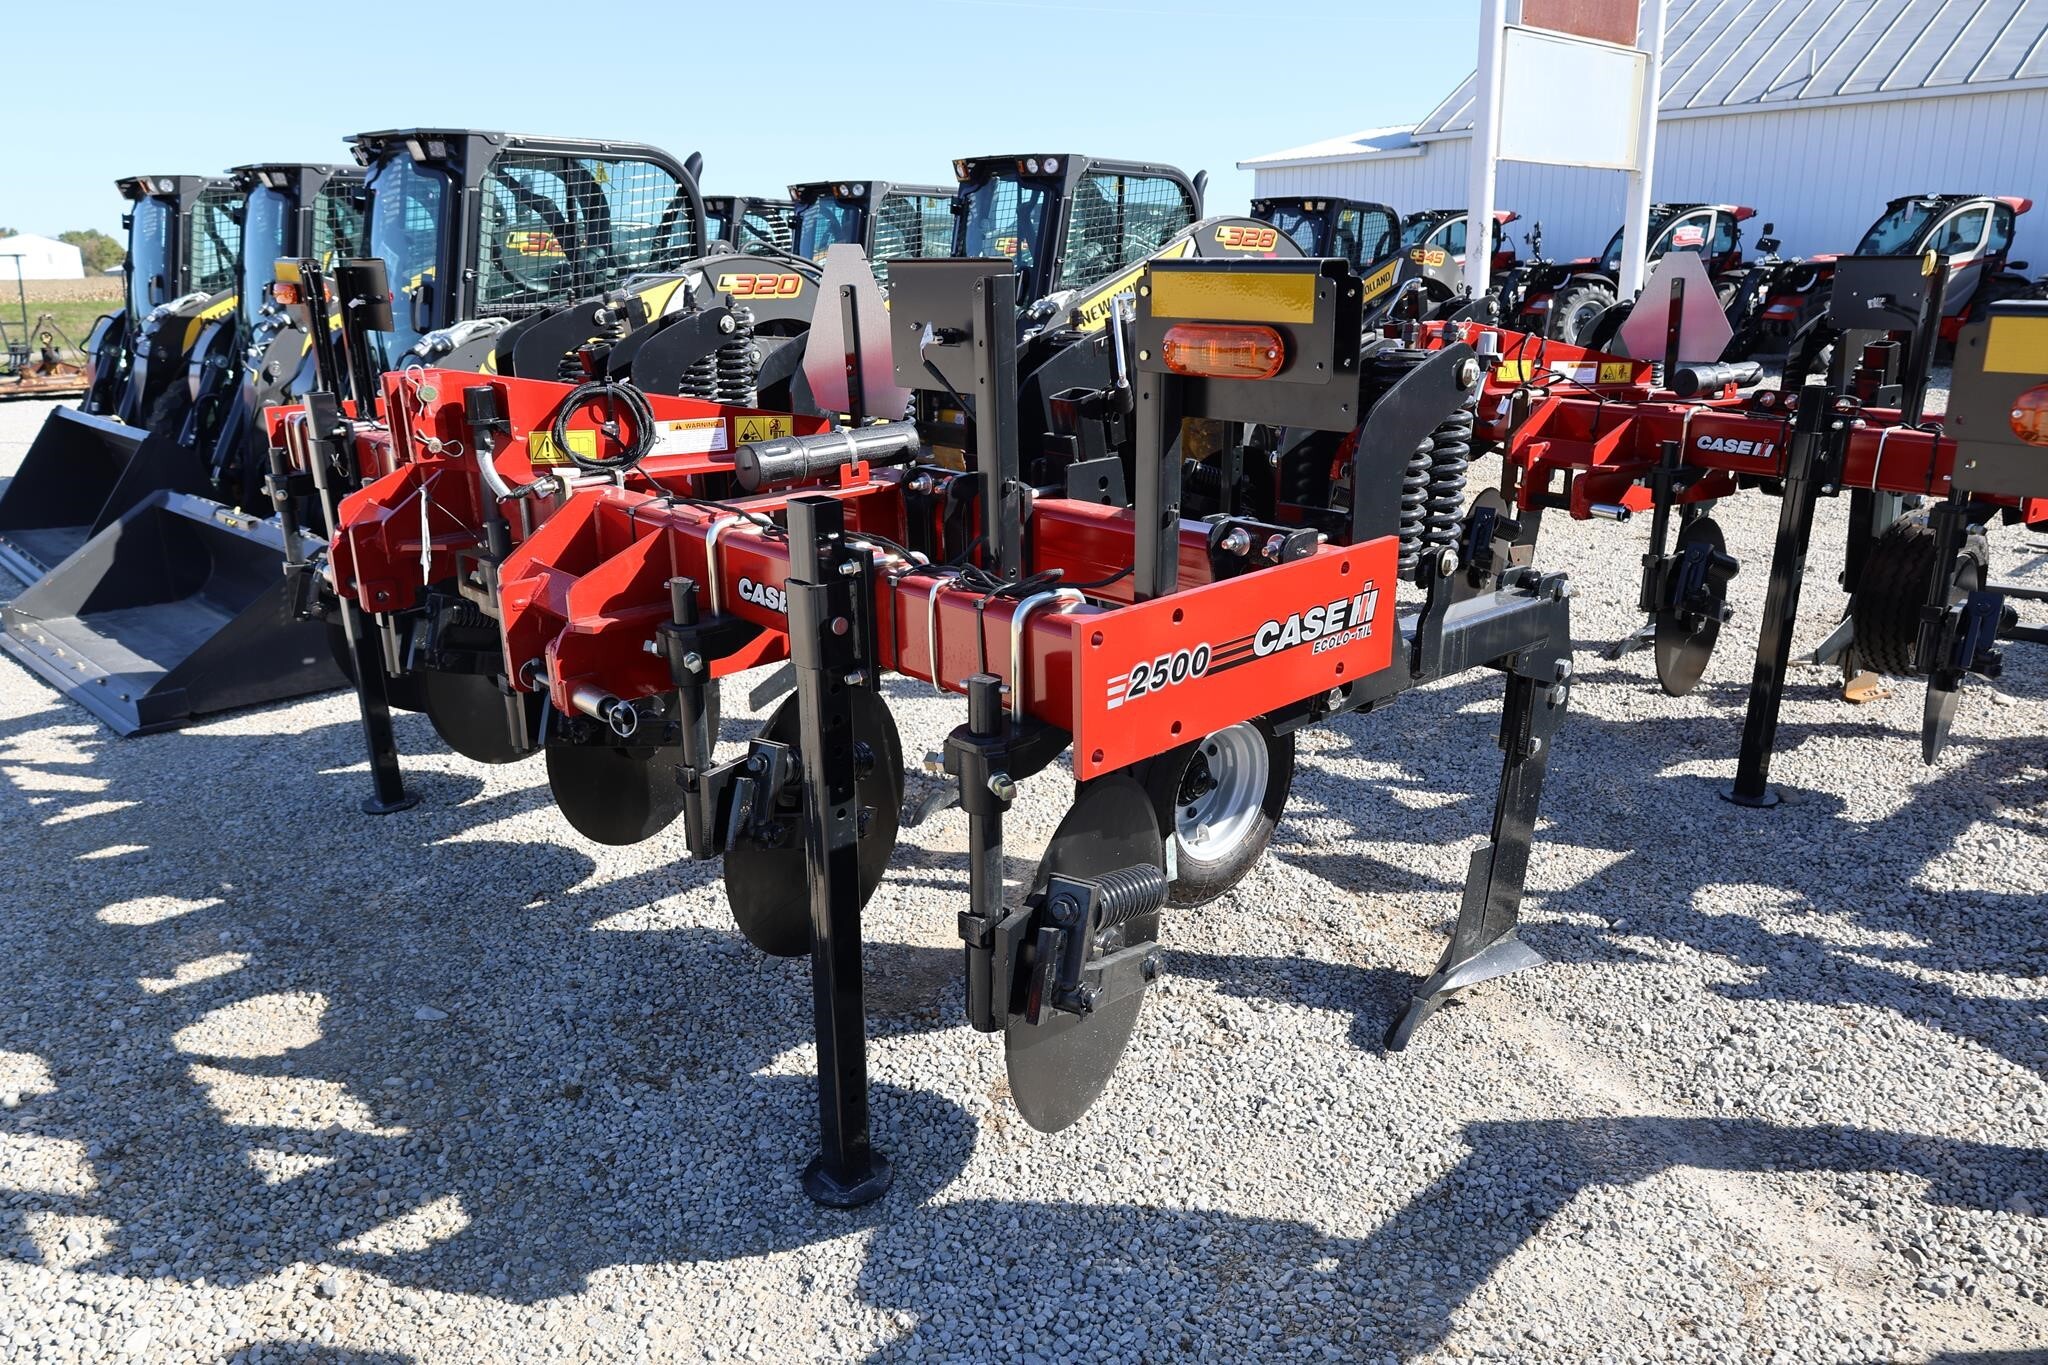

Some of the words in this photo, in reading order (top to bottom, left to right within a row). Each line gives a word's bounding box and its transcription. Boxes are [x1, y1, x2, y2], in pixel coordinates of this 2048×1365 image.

[1215, 226, 1277, 251] L328
[718, 274, 802, 298] L320
[1364, 272, 1391, 295] OLLAND
[1080, 297, 1111, 327] NEW
[685, 421, 719, 429] WARNING
[1696, 435, 1753, 455] CASE
[1253, 598, 1349, 657] CASE
[1312, 624, 1372, 656] ECOLO-TIL
[1125, 643, 1210, 701] 2500
